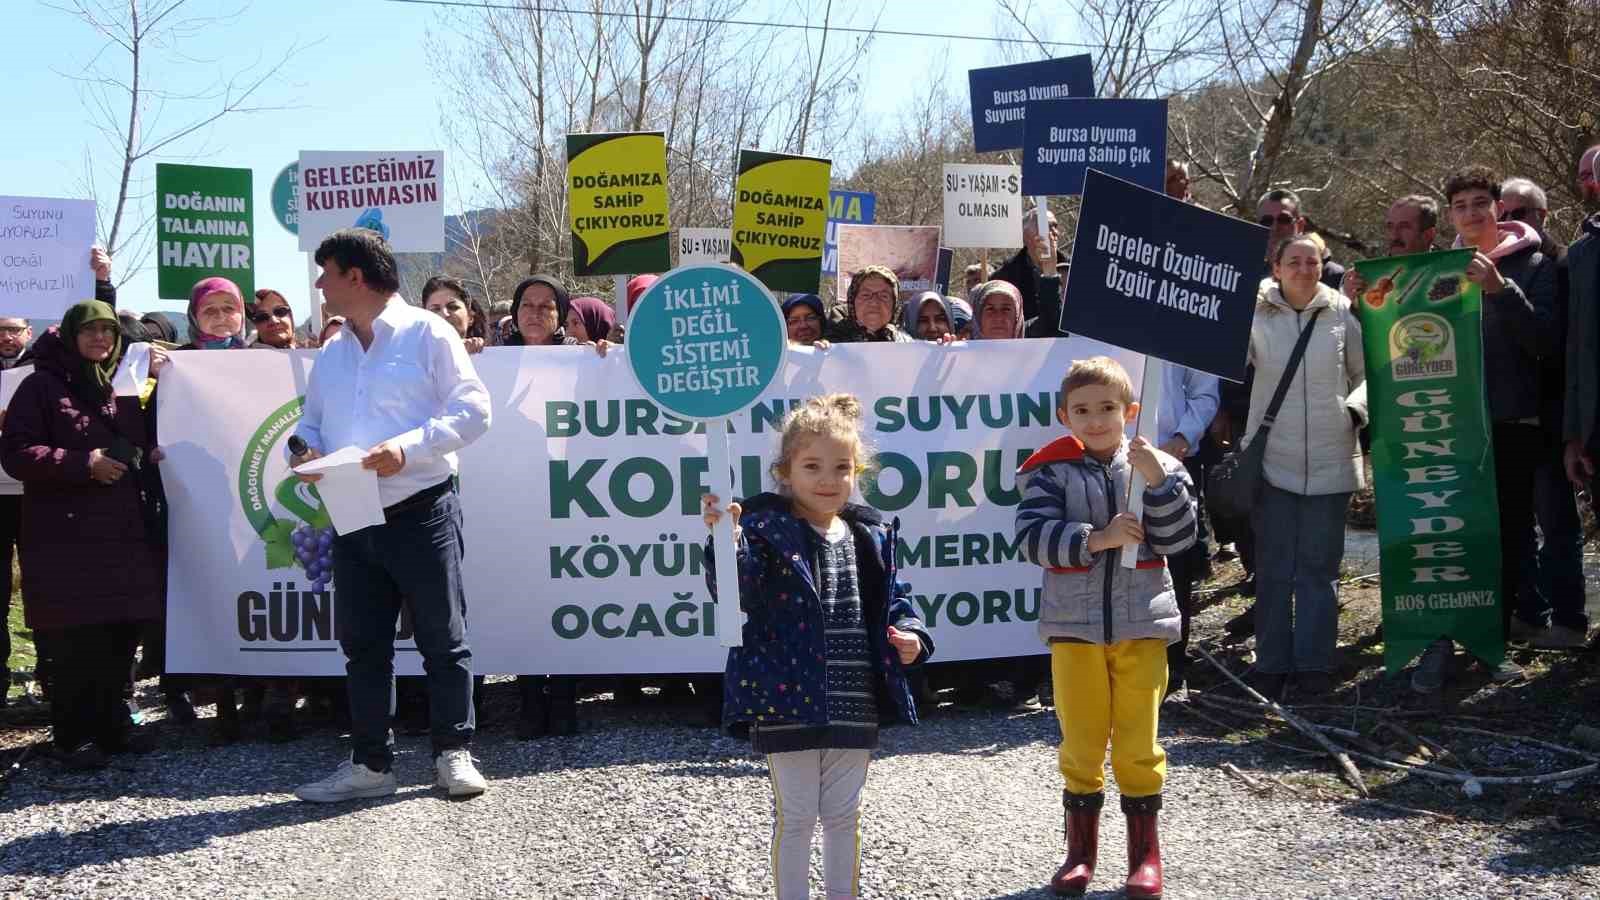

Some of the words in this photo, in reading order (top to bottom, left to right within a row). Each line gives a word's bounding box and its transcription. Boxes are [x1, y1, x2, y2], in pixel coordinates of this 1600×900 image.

[993, 88, 1027, 105] Bursa
[985, 106, 1026, 124] Suyuna
[1050, 126, 1088, 143] Bursa
[1091, 126, 1137, 144] Uyuma
[1037, 146, 1086, 164] Suyuna
[1088, 146, 1126, 165] Sahip
[1129, 146, 1152, 167] Çık
[304, 155, 436, 187] GELECEĞİMİZ
[572, 170, 663, 188] DOĞAMIZA
[306, 182, 437, 211] KURUMASIN
[946, 174, 959, 192] SU
[968, 174, 999, 197] YAŞAM
[164, 191, 245, 213] DOĞANIN
[593, 191, 644, 208] SAHİP
[739, 189, 824, 211] DOĞAMIZA
[958, 203, 1009, 218] OLMASIN
[161, 217, 249, 237] TALANINA
[575, 213, 665, 233] ÇIKIYORUZ
[756, 212, 804, 228] SAHİP
[682, 238, 693, 254] SU
[735, 230, 821, 250] ÇIKIYORUZ
[162, 241, 251, 269] HAYIR
[1096, 223, 1161, 268] Dereler
[1162, 241, 1242, 293] Özgürdür
[663, 278, 741, 311] İKLİMİ
[1105, 257, 1156, 301] Özgür
[1156, 279, 1222, 321] Akacak
[671, 307, 739, 338] DEĞİL
[661, 333, 752, 366] SİSTEMİ
[657, 361, 760, 395] DEĞİŞTİR
[874, 391, 1064, 432] SUYUN
[1395, 388, 1471, 583] GÜNEYDER
[551, 591, 715, 639] OCAĞI
